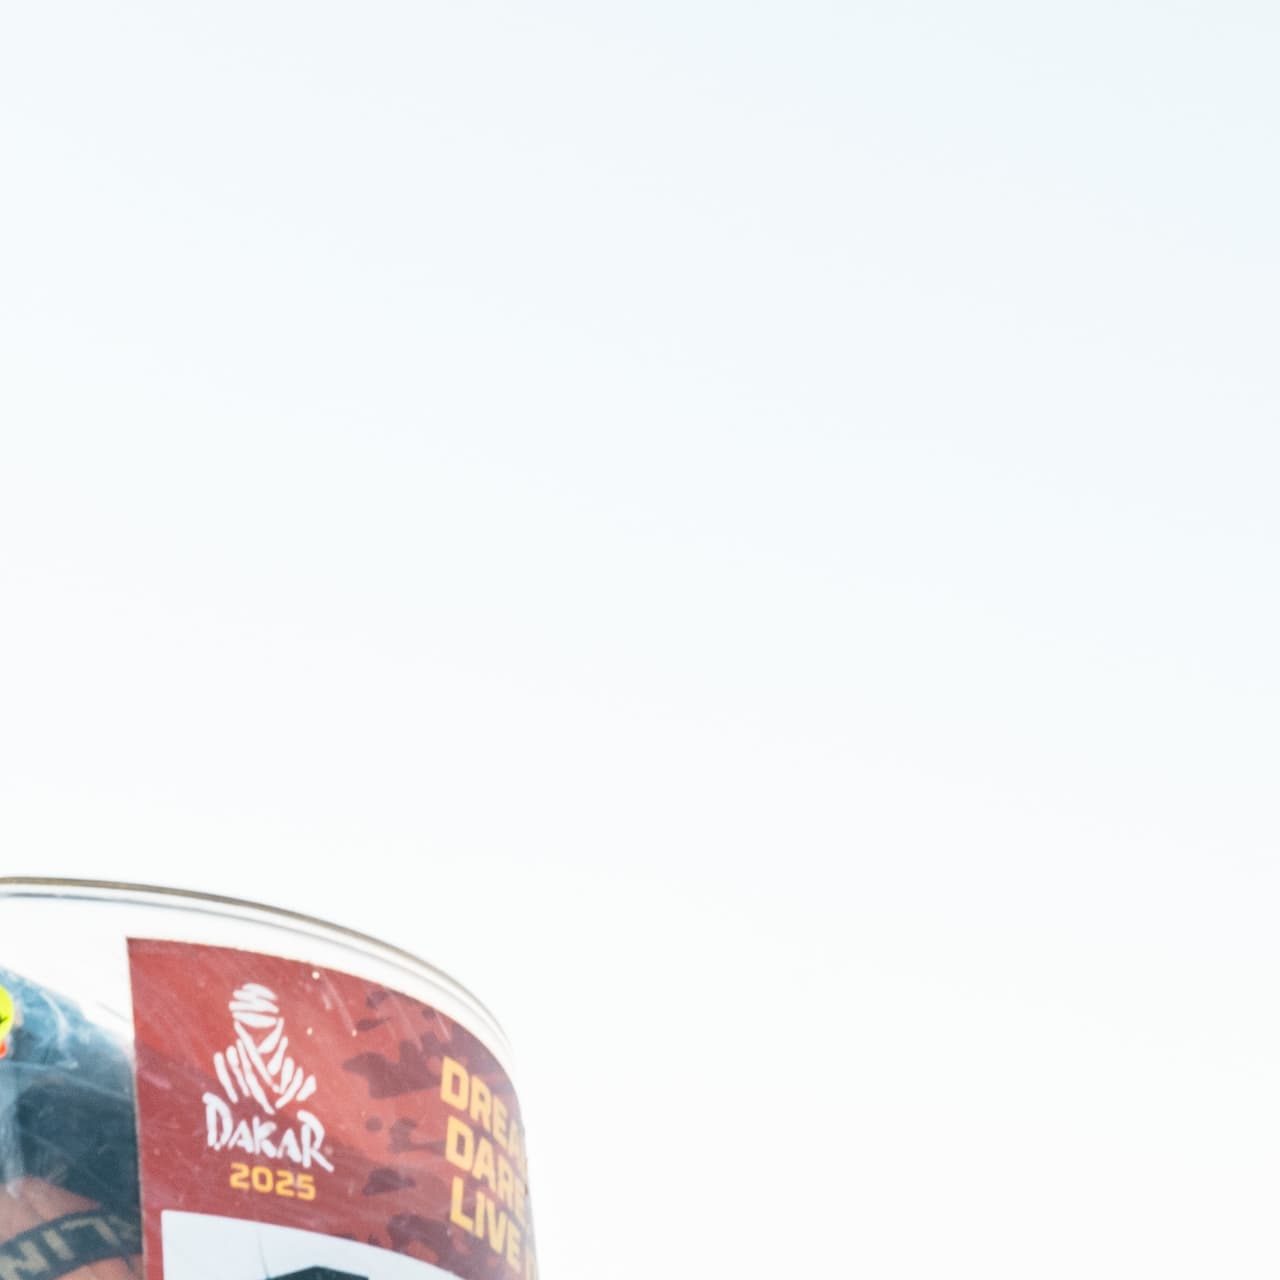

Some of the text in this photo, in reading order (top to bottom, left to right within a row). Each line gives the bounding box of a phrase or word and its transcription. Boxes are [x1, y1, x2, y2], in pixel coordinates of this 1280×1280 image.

[202, 1091, 335, 1173] DAKAR
[441, 1055, 527, 1172] DREA
[229, 1162, 316, 1201] 2025
[450, 1176, 522, 1274] LIVE
